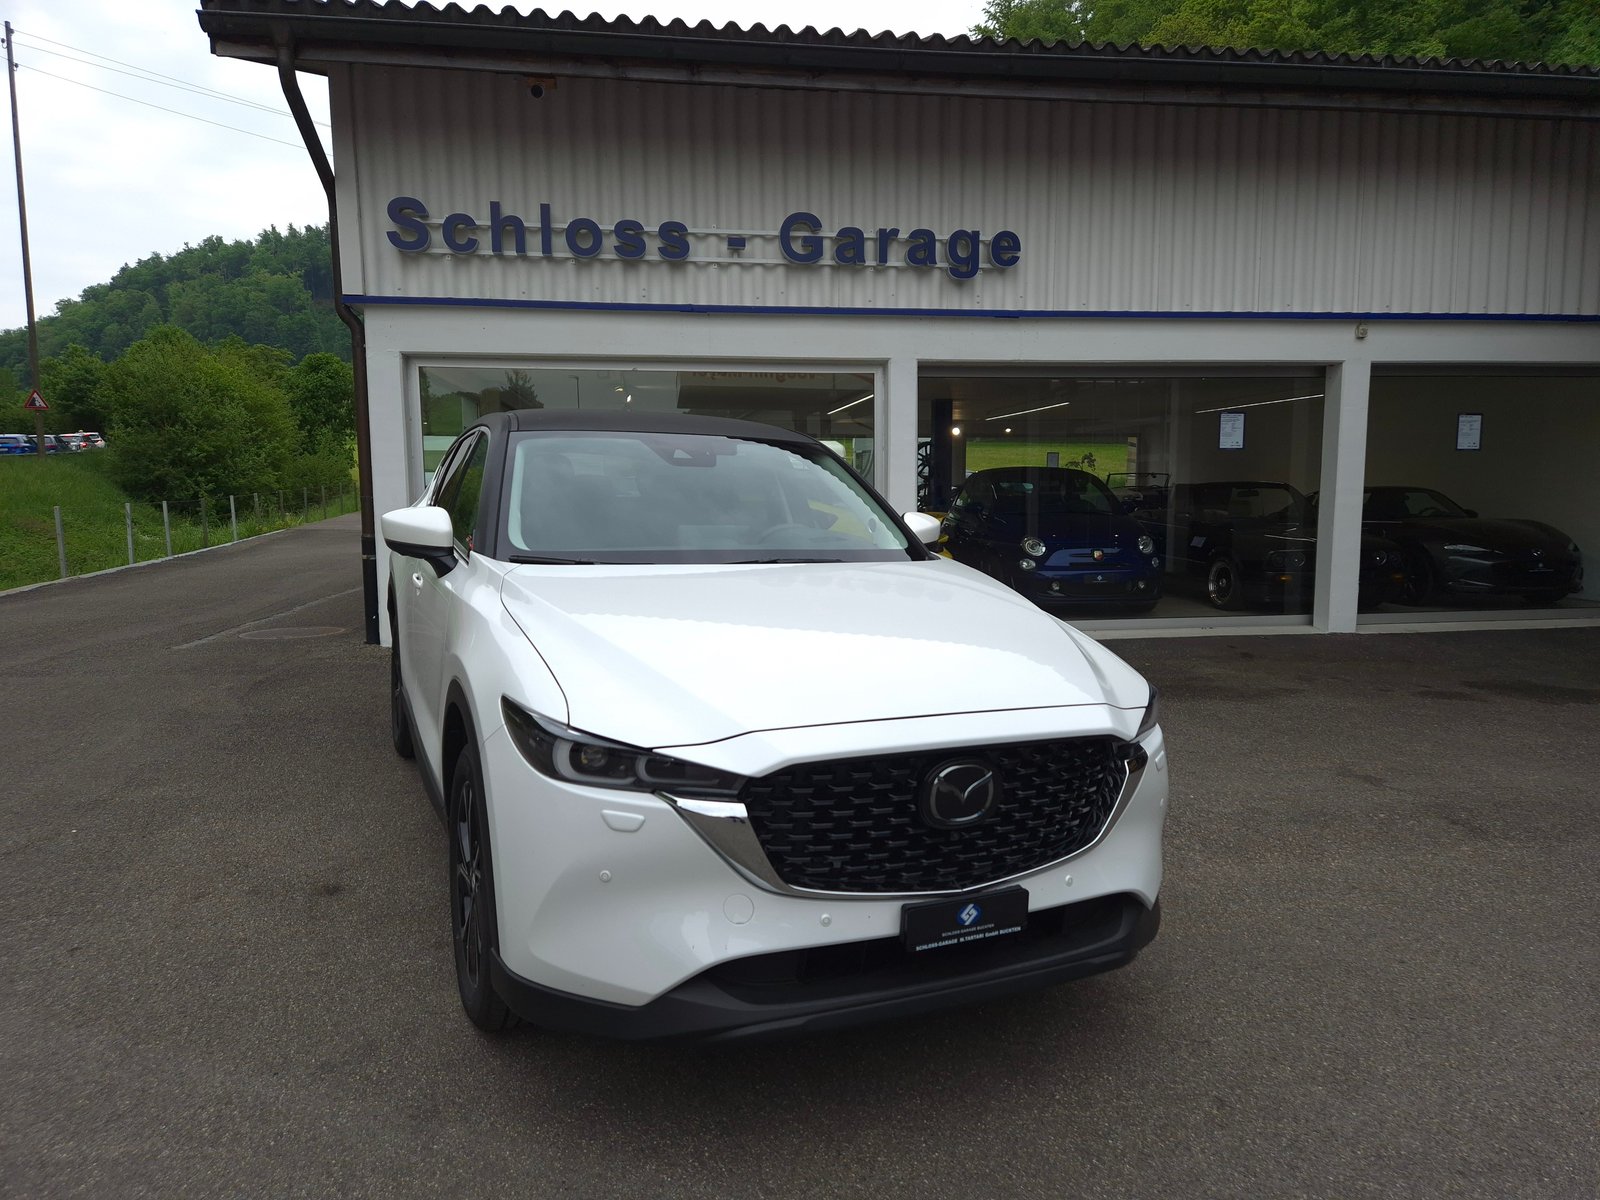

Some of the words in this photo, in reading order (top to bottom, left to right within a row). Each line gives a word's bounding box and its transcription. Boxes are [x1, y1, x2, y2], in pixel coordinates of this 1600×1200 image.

[386, 196, 691, 261] Schloss
[727, 237, 746, 250] -
[780, 211, 1022, 280] Garage
